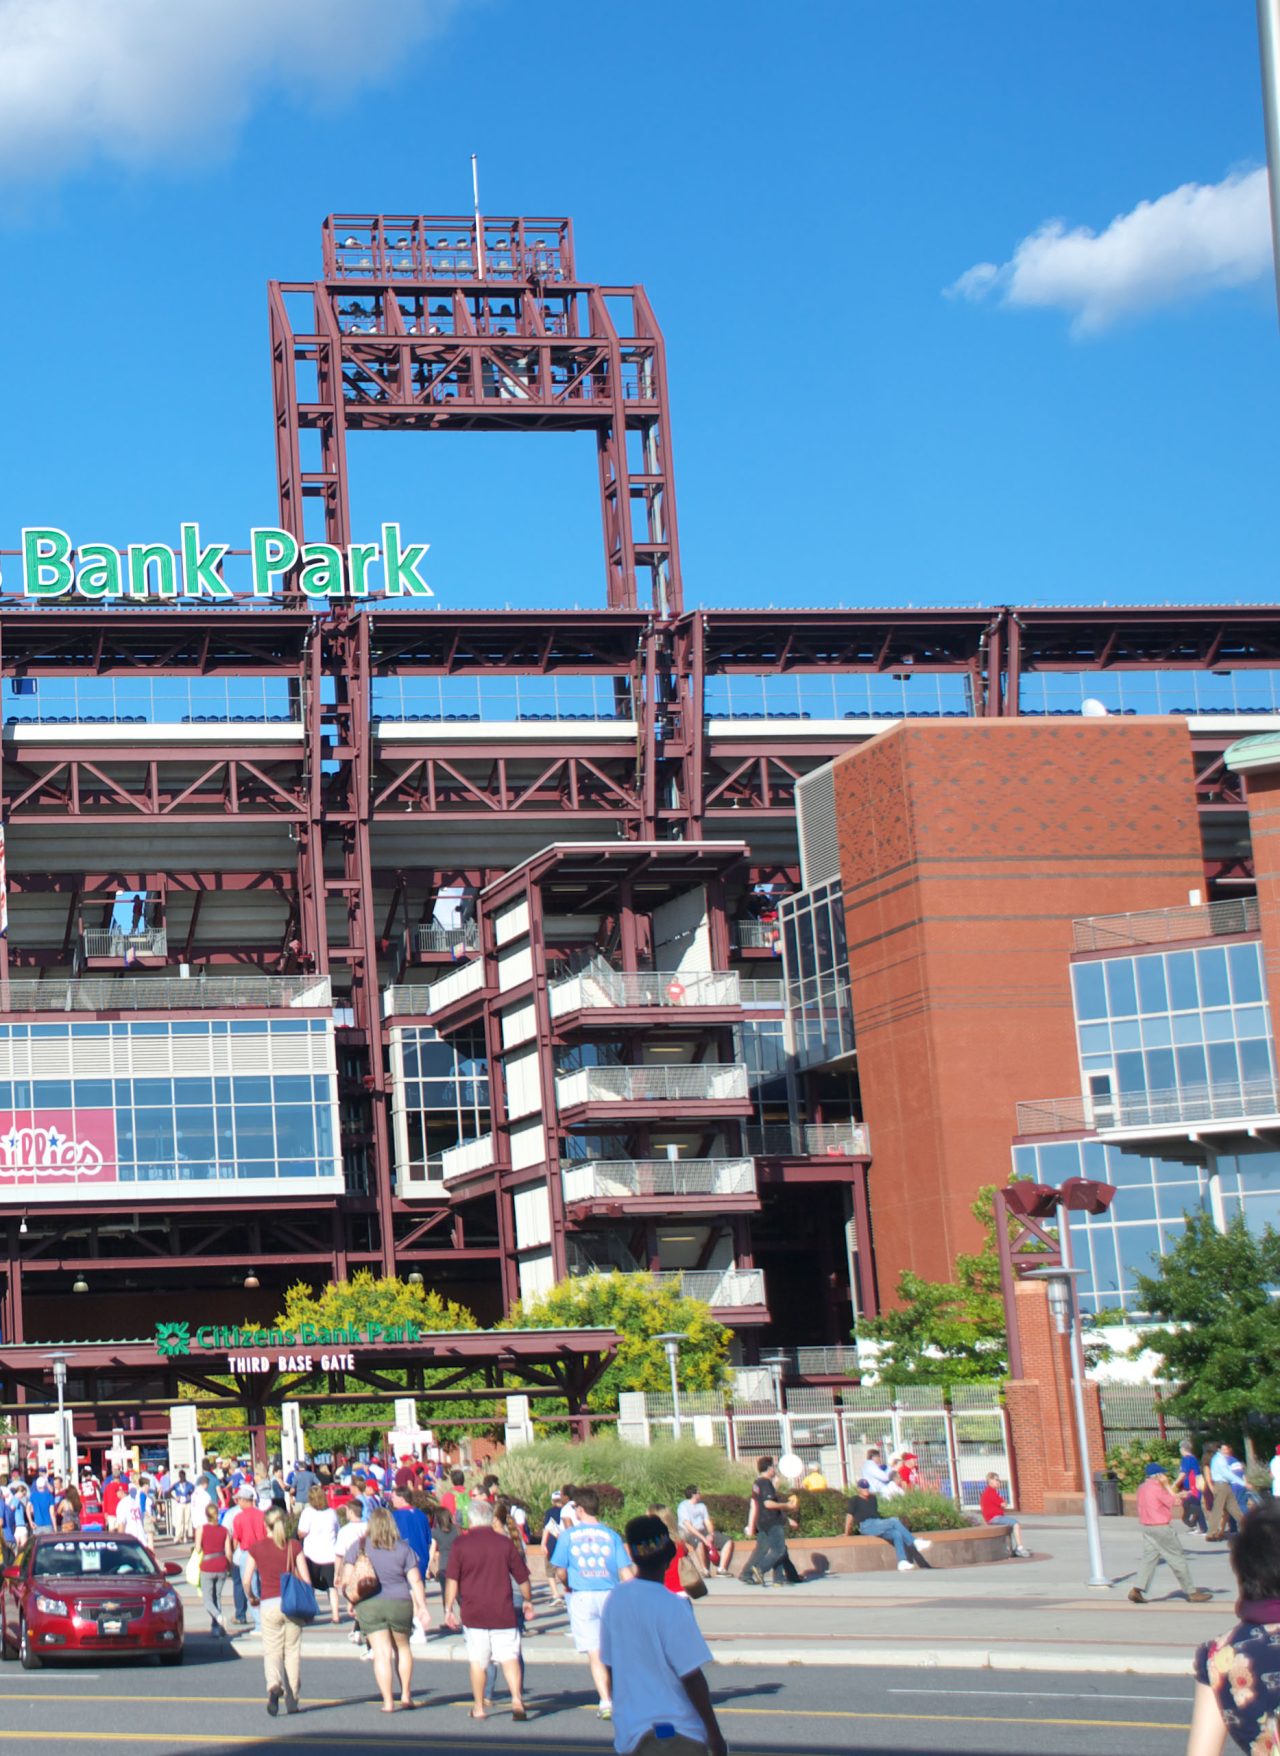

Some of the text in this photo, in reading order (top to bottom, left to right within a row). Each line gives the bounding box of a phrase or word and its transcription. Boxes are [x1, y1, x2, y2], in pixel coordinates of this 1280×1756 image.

[22, 522, 234, 598] Bank
[251, 522, 435, 598] Park
[195, 1319, 421, 1350] Citizens Bank Park
[228, 1354, 355, 1373] THIRD BASE GATE
[54, 1541, 118, 1551] 42 MPG
